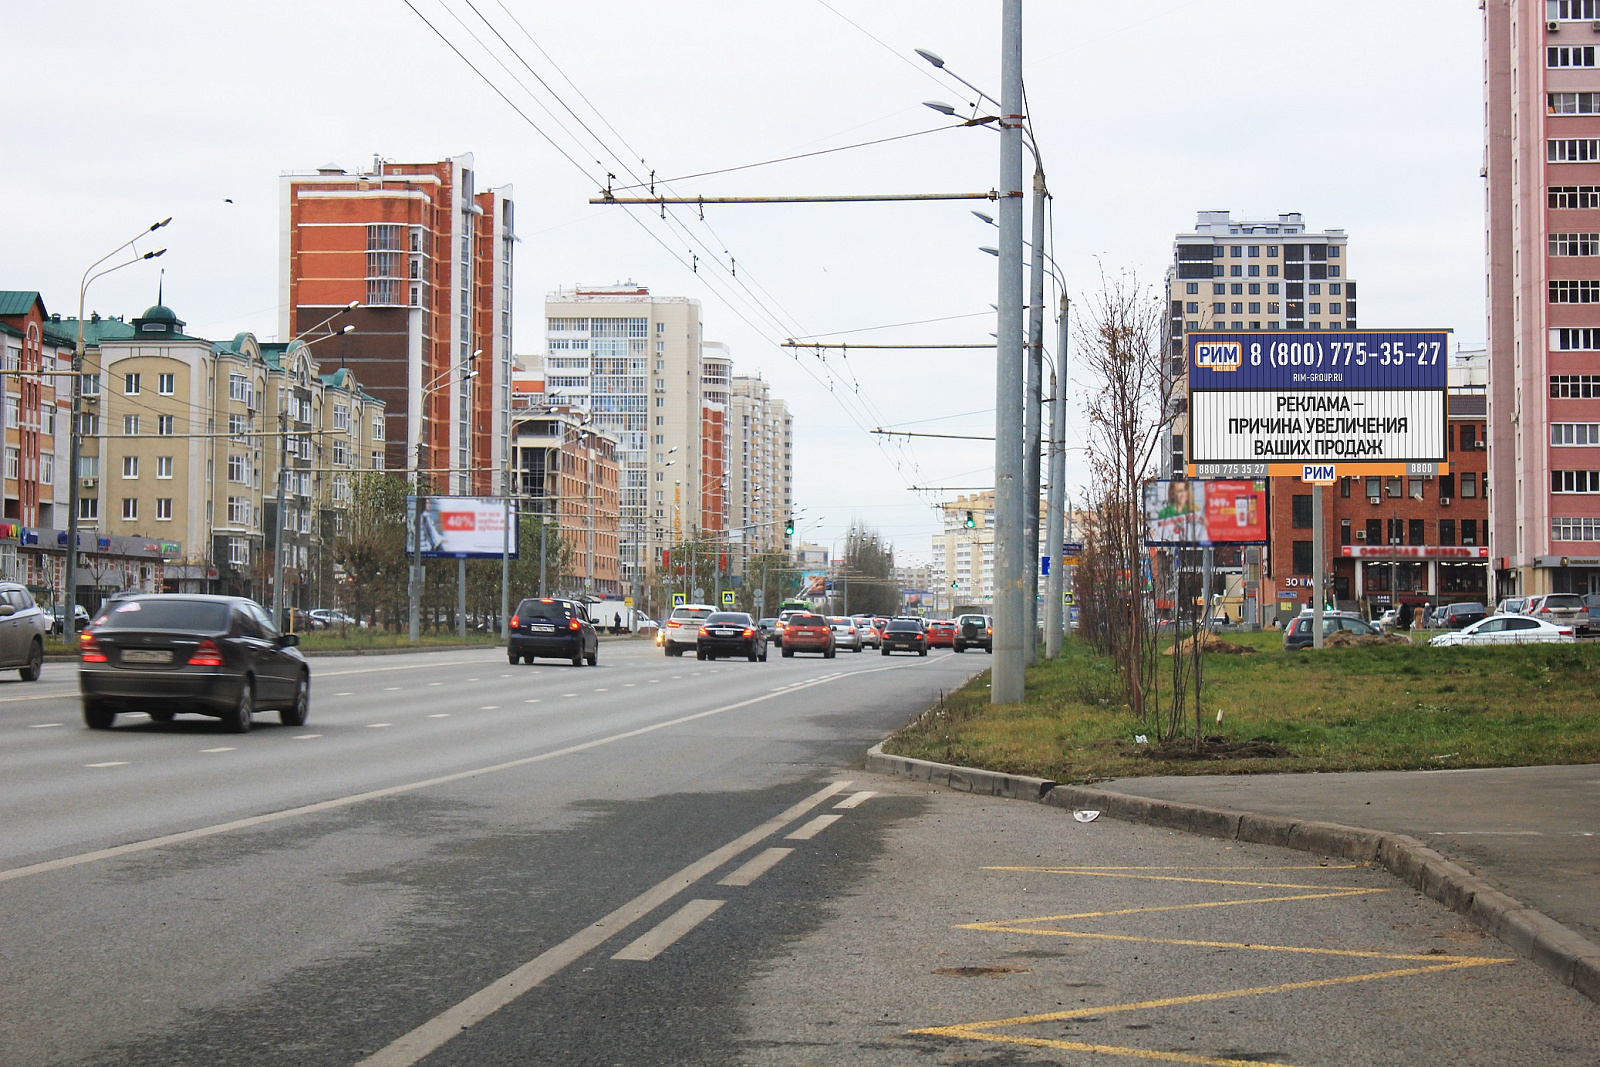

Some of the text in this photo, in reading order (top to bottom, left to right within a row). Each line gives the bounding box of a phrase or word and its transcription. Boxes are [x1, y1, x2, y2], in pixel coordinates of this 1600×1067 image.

[1199, 346, 1238, 363] РИМ
[1250, 341, 1442, 368] 8 (800) 775-35-27
[1293, 373, 1343, 382] RIM-GROUP.RU
[1276, 396, 1351, 412] РЕКЛАМА
[1228, 417, 1408, 435] ПРИЧИНА УВЕЛИЧЕНИЯ
[1254, 439, 1384, 458] ВАШИХ ПРОДАЖ
[1199, 464, 1265, 474] 8800 775 35 27
[1304, 466, 1334, 480] РИМ
[1411, 463, 1432, 473] 8800
[447, 515, 473, 527] 40%
[1359, 547, 1418, 557] ОФИСНАЯ
[1424, 547, 1471, 557] МЕБЕЛЬ
